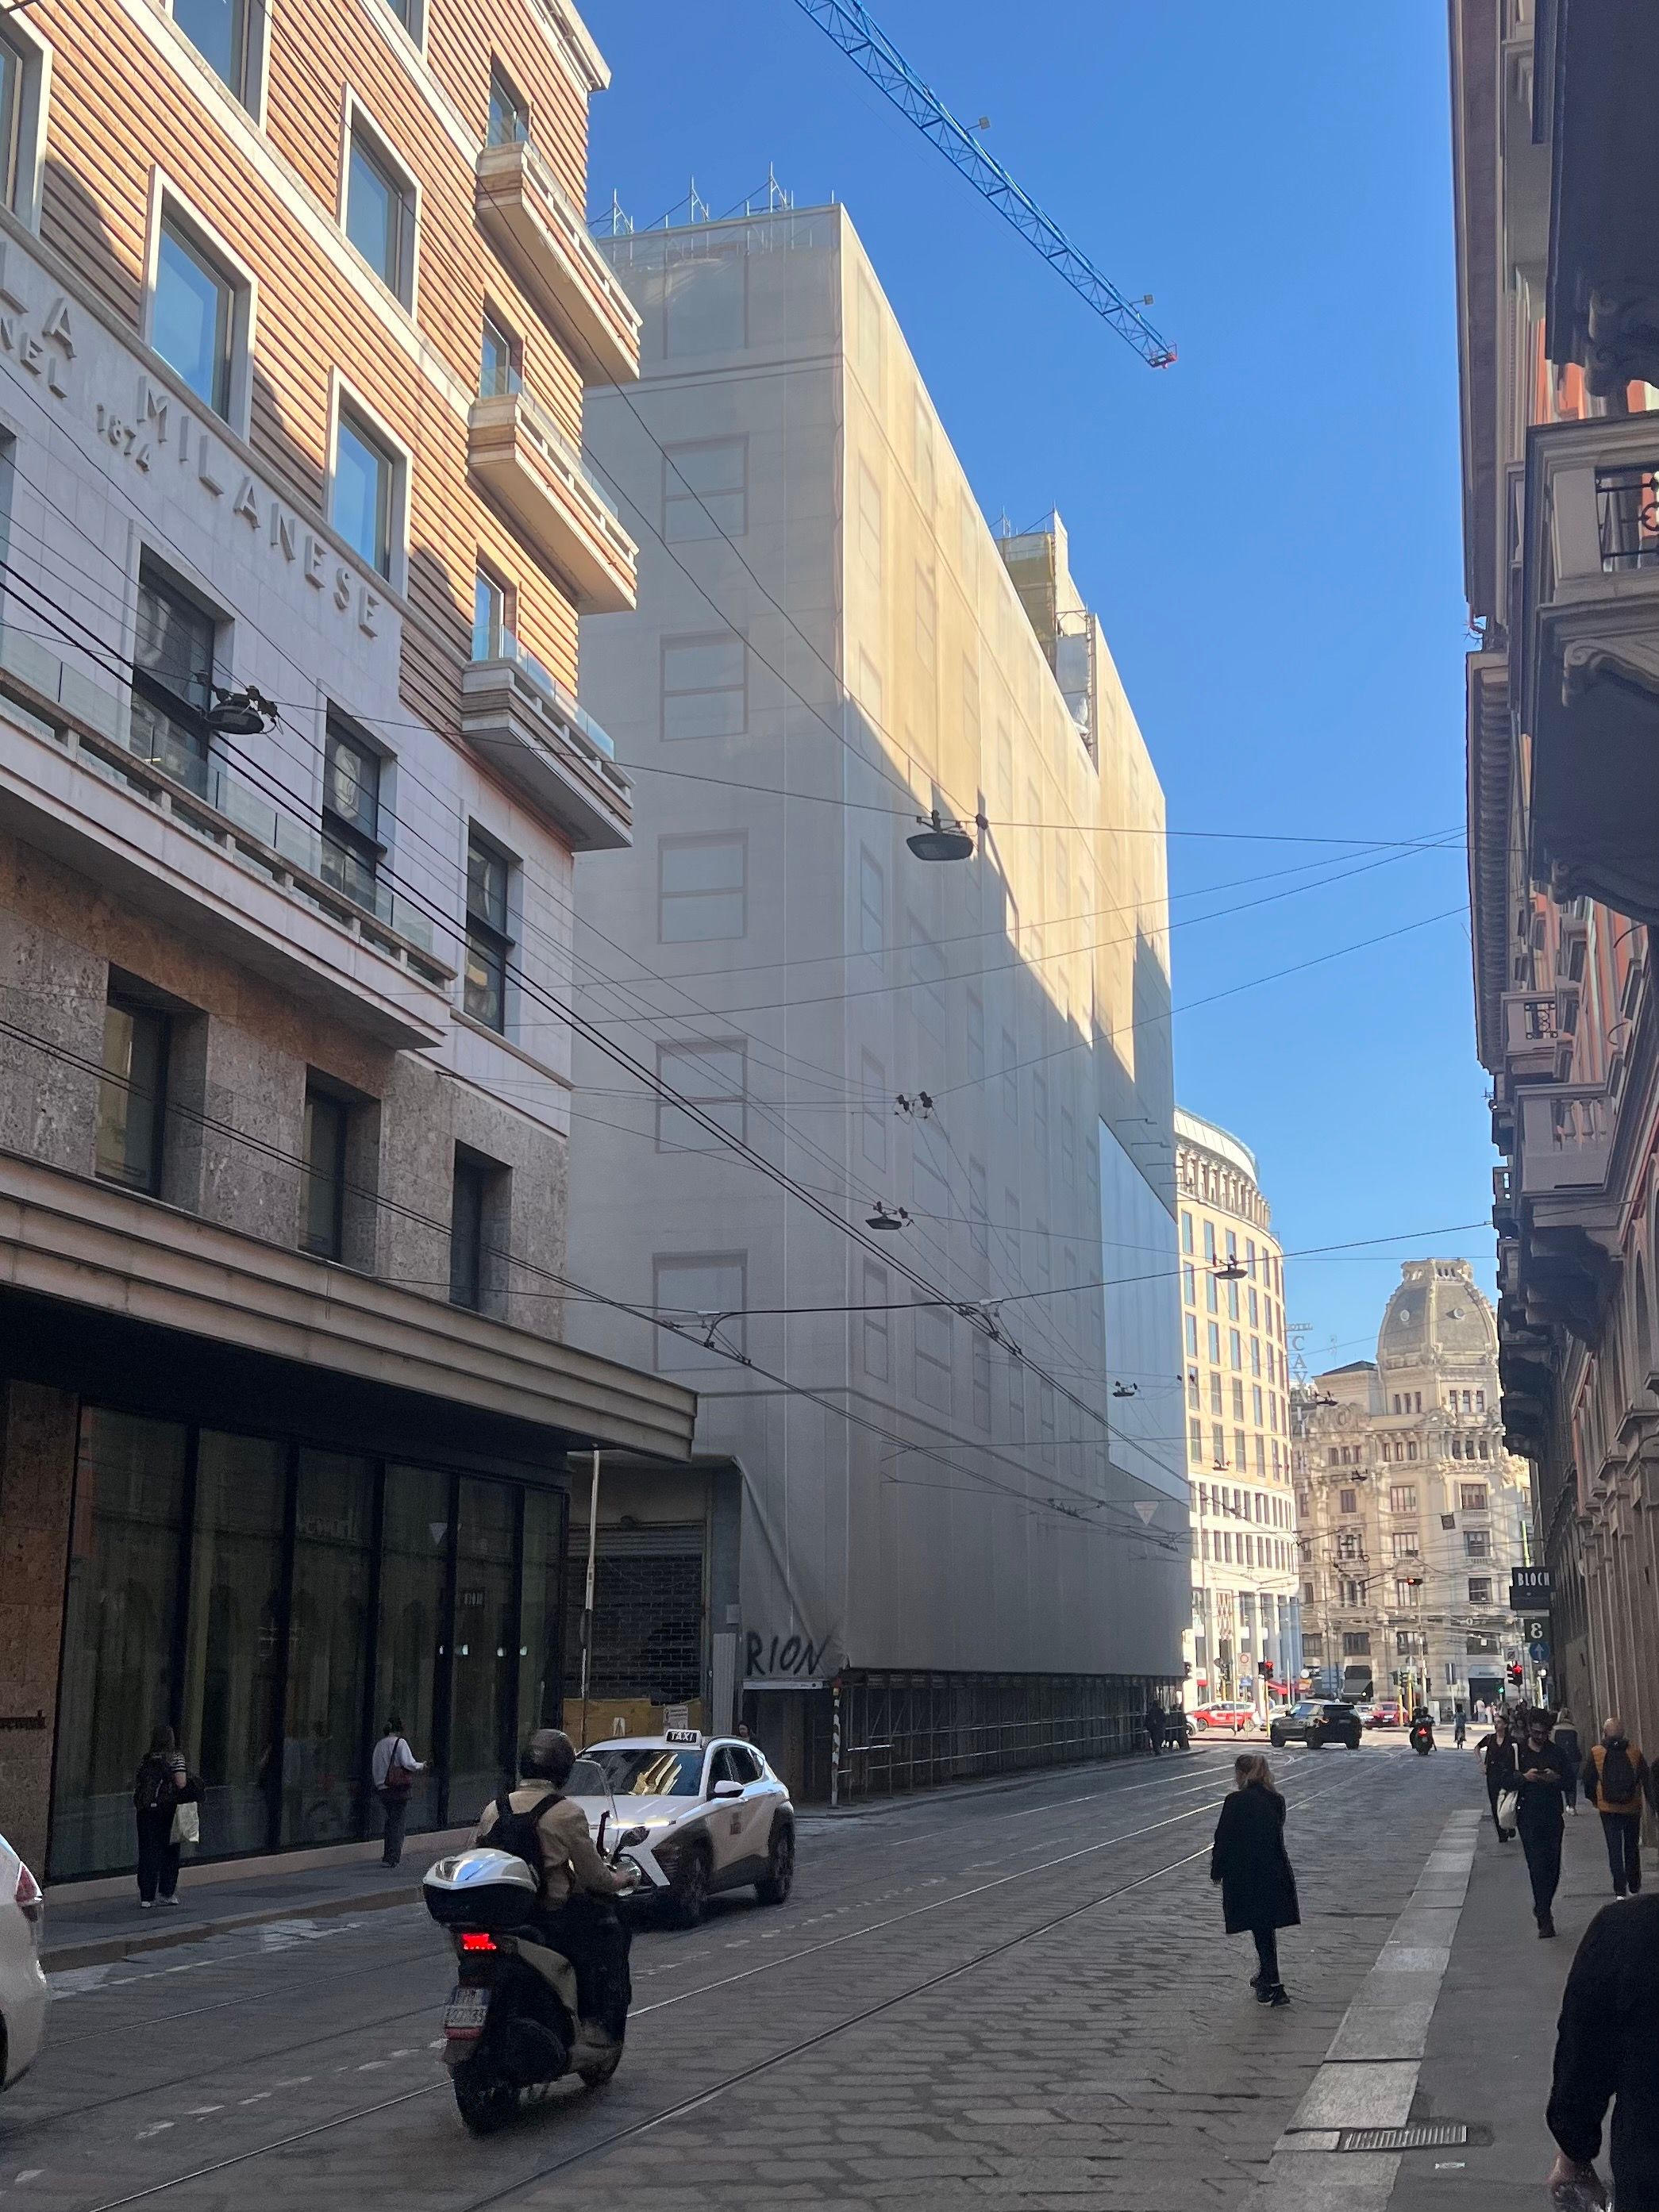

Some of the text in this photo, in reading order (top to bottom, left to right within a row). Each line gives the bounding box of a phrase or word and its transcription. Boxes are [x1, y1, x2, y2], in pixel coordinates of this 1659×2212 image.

[96, 403, 152, 473] 1874
[137, 375, 379, 637] MILANESE
[1518, 1572, 1550, 1587] BLOCH
[746, 1631, 831, 1675] RION
[671, 1731, 695, 1742] TAXI
